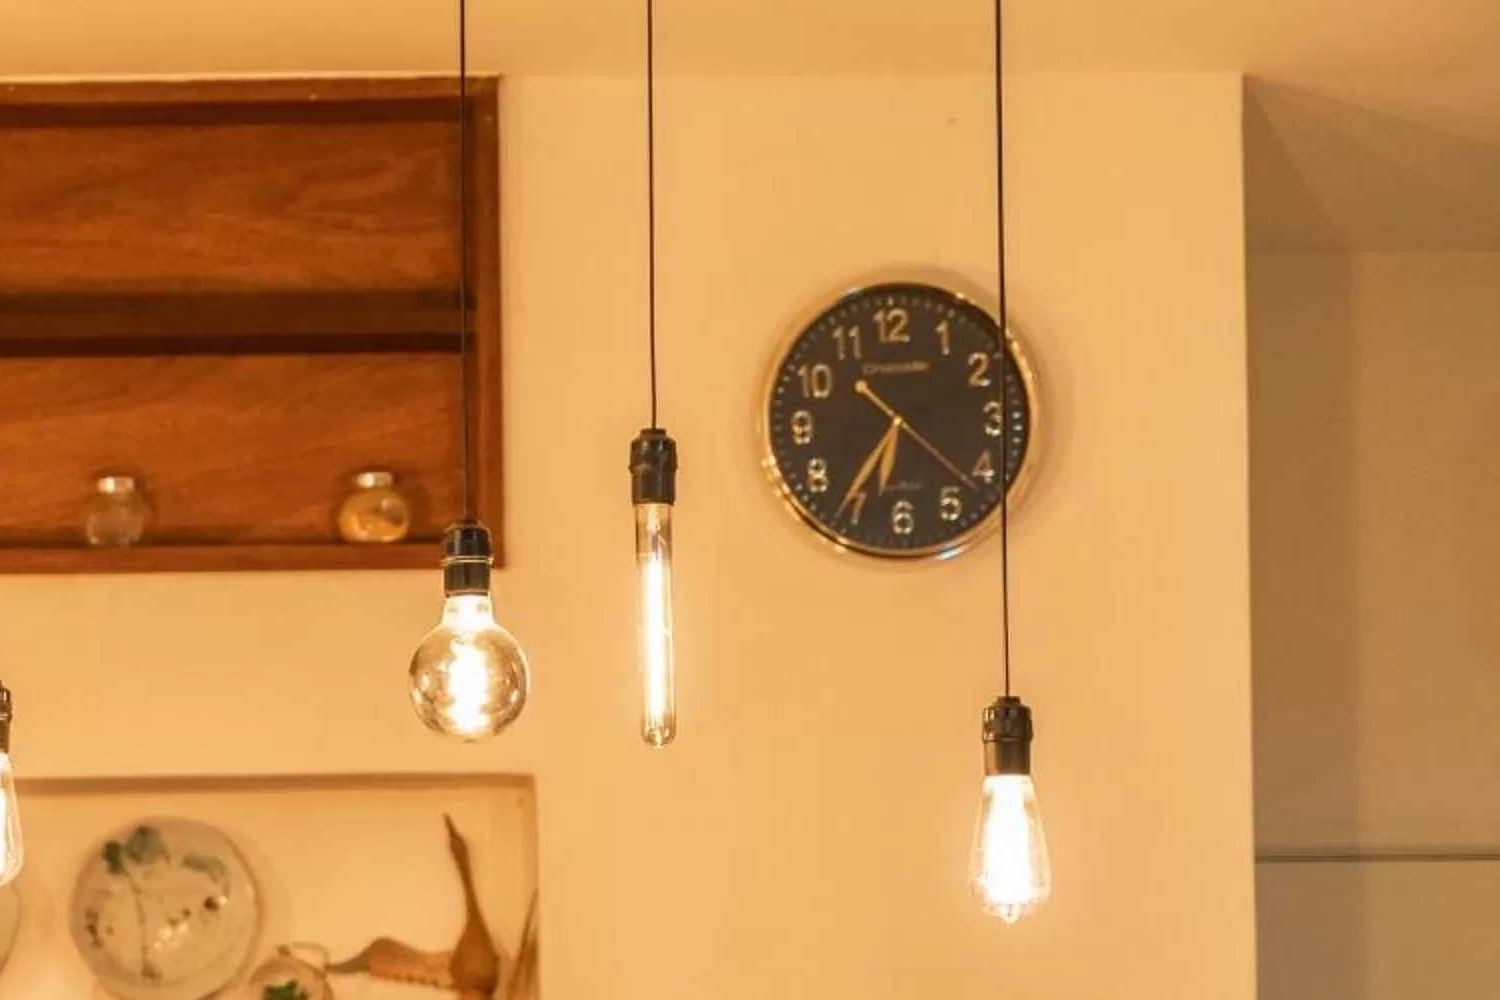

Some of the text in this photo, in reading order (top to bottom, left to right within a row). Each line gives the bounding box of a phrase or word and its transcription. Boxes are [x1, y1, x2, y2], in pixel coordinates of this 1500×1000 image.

[832, 325, 863, 361] 11
[873, 309, 911, 343] 12
[936, 320, 949, 355] 1
[798, 364, 833, 398] 10
[967, 352, 991, 387] 2
[790, 410, 813, 445] 9
[983, 401, 1002, 436] 3
[807, 457, 829, 493] 8
[972, 451, 995, 484] 4
[891, 500, 914, 535] 6
[940, 486, 962, 521] 5
